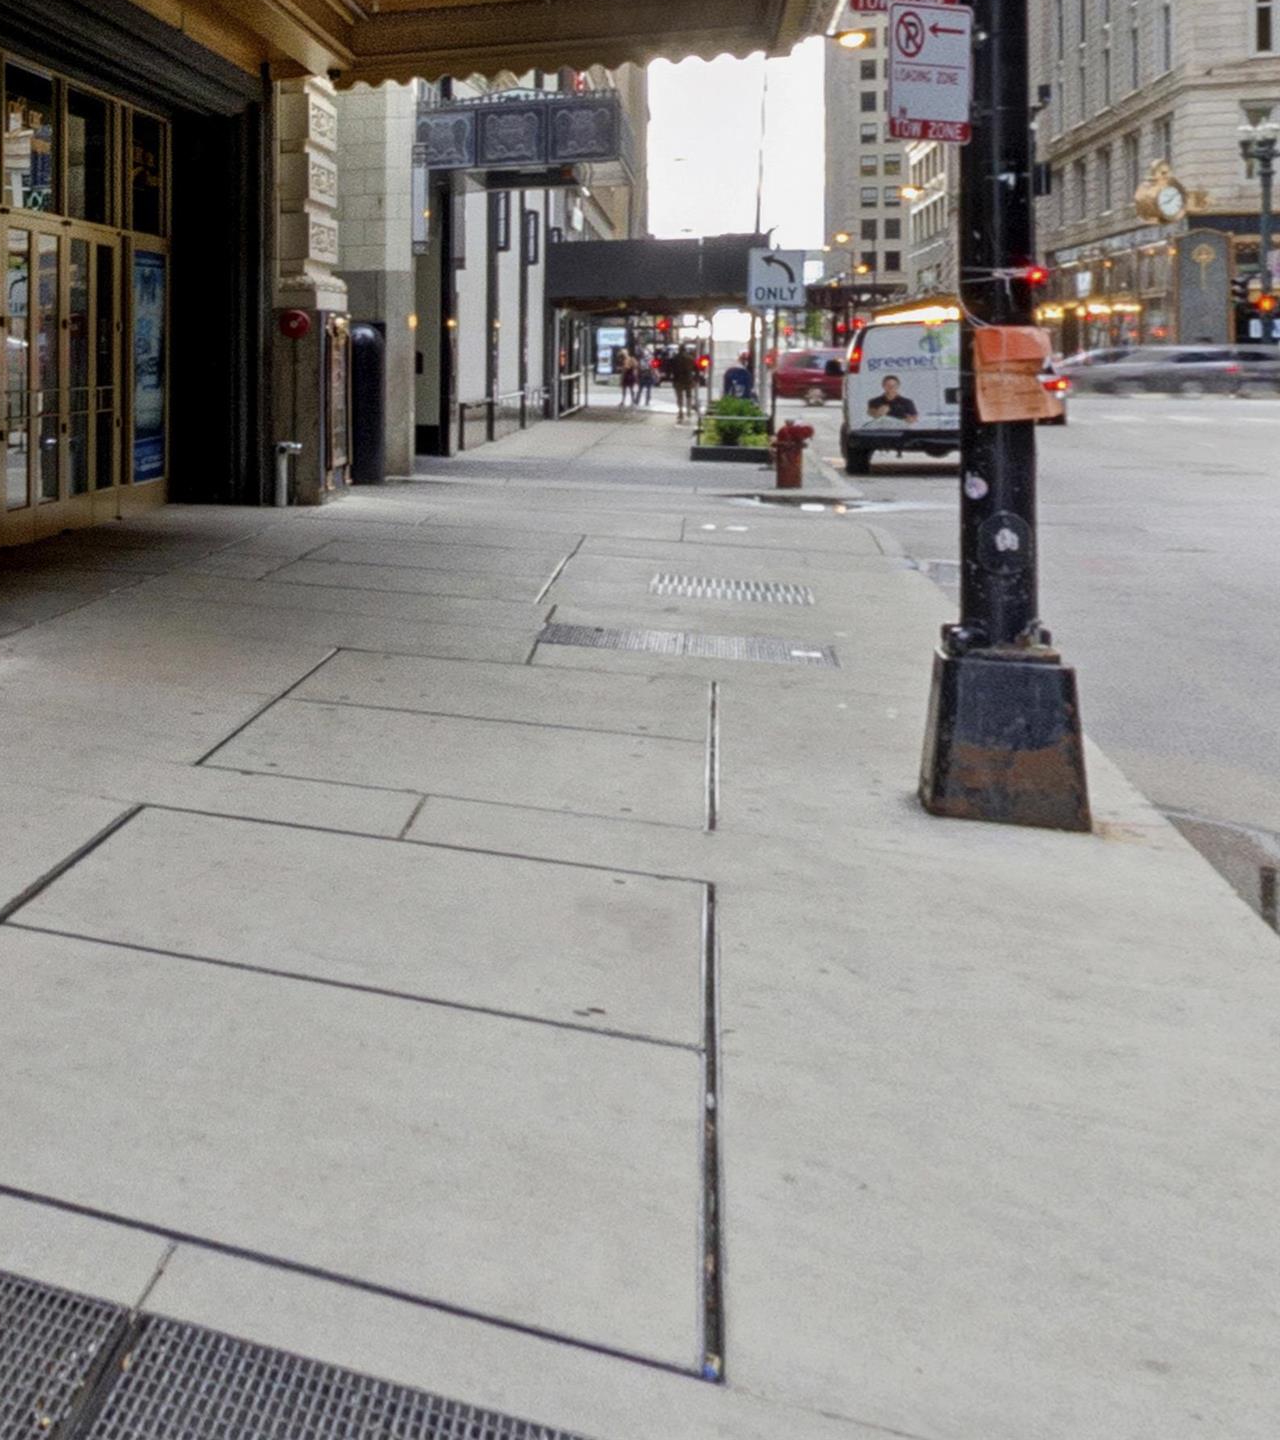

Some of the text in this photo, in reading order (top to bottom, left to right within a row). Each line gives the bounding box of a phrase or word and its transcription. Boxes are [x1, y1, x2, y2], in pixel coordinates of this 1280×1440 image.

[895, 120, 964, 140] TOW ZONE
[755, 285, 798, 301] ONLY
